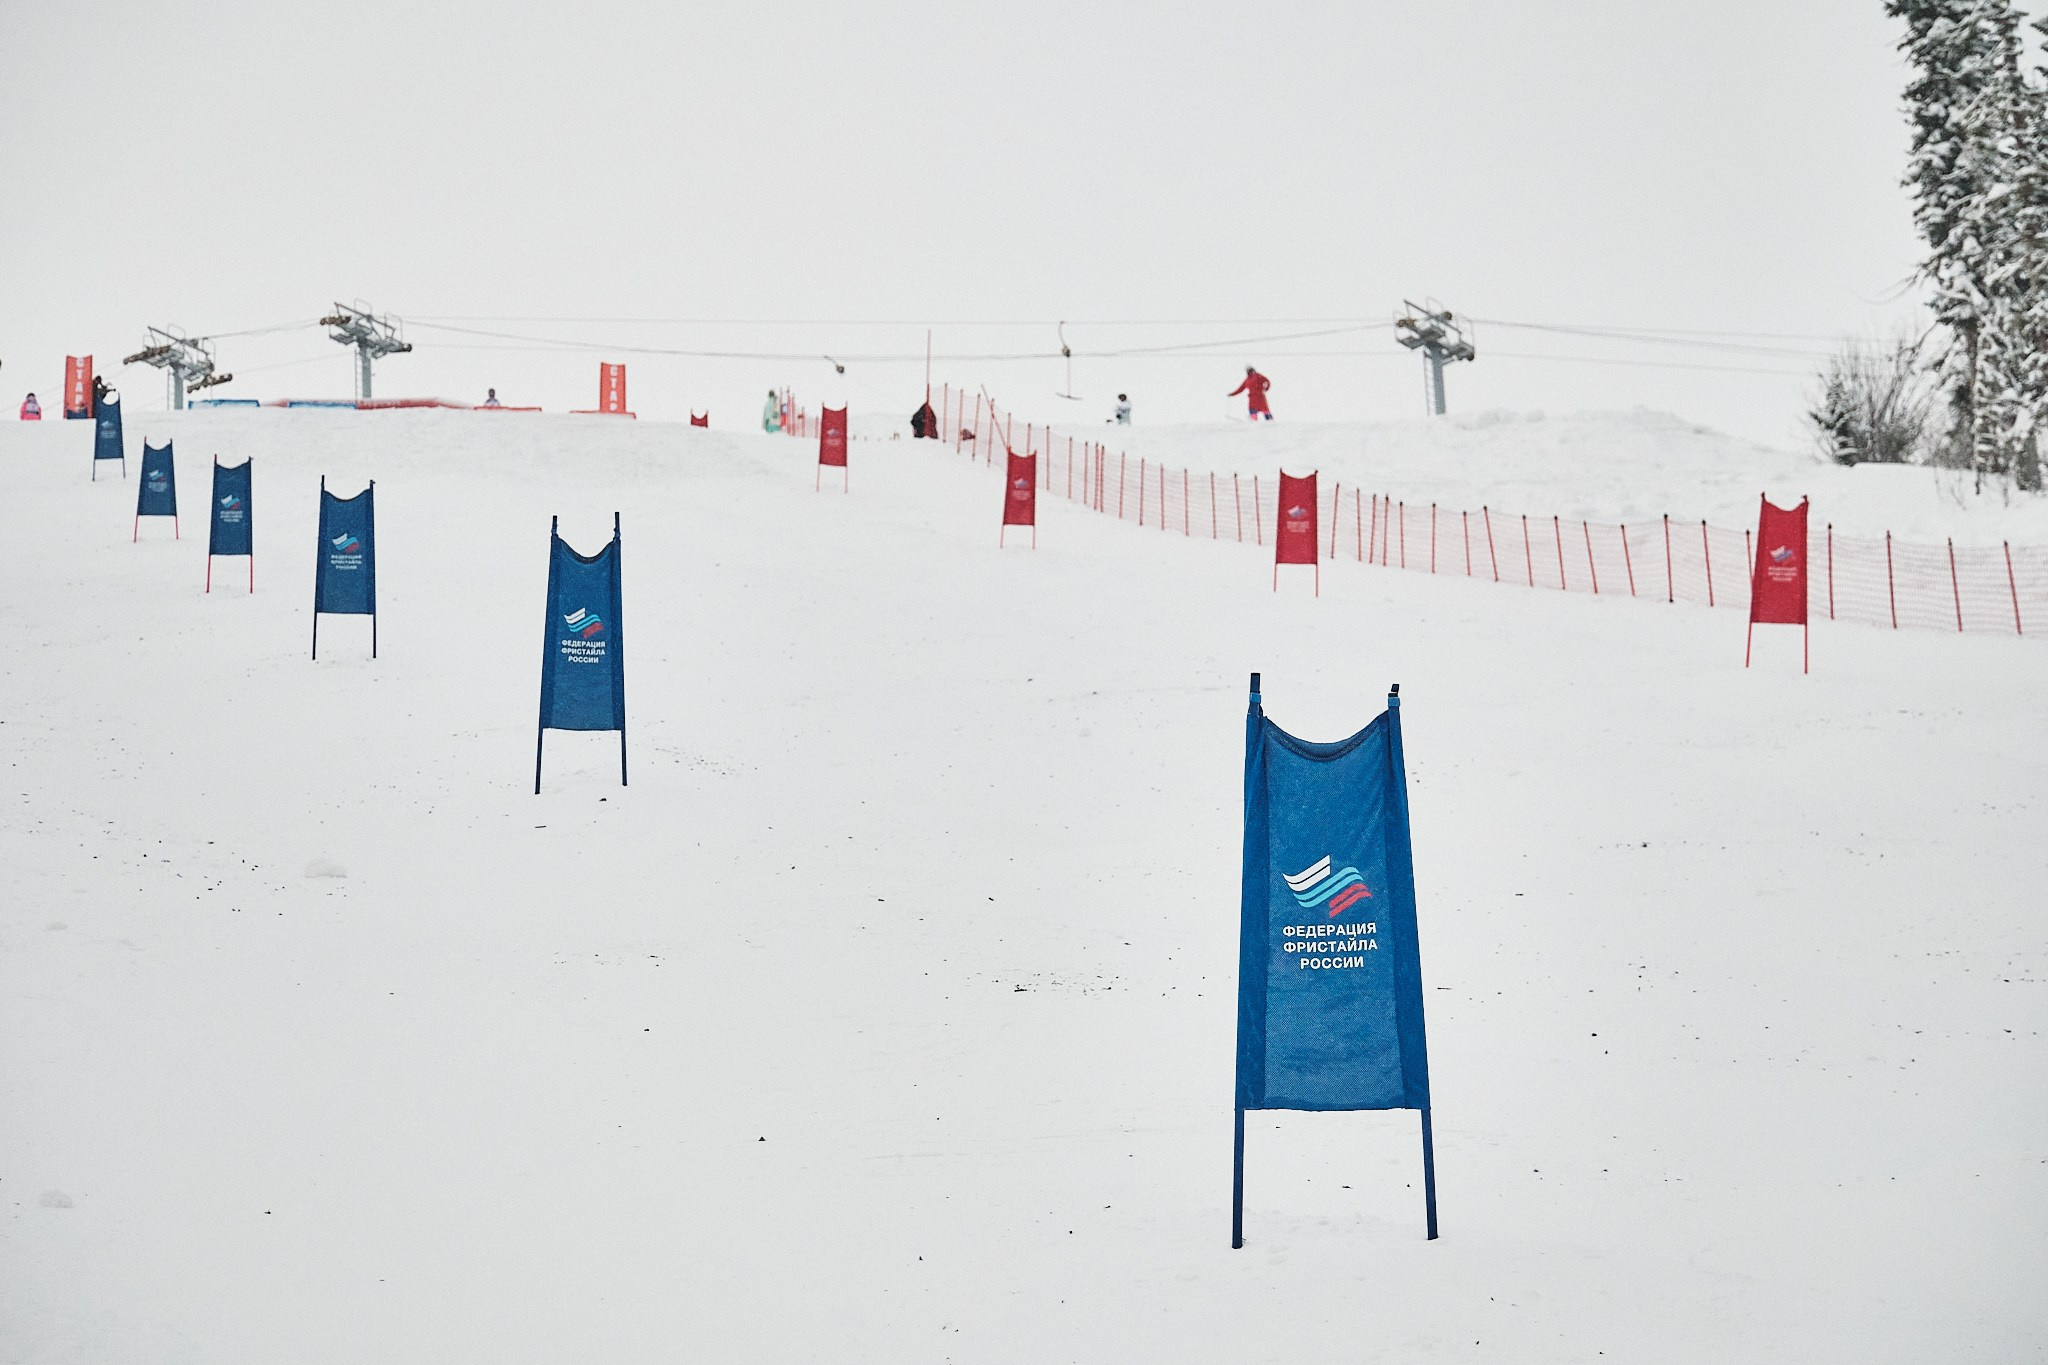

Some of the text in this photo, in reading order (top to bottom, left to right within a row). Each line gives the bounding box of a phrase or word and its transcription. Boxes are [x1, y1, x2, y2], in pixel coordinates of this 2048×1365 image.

[75, 357, 85, 410] СТАР
[561, 639, 606, 648] ФЕДЕРАЦИЯ
[561, 647, 606, 656] ФРИСТАЙЛА
[568, 656, 599, 664] РОССИИ
[1282, 922, 1377, 939] ФЕДЕРАЦИЯ
[1283, 937, 1378, 953] ФРИСТАЙЛА
[1300, 956, 1364, 970] РОССИИ
